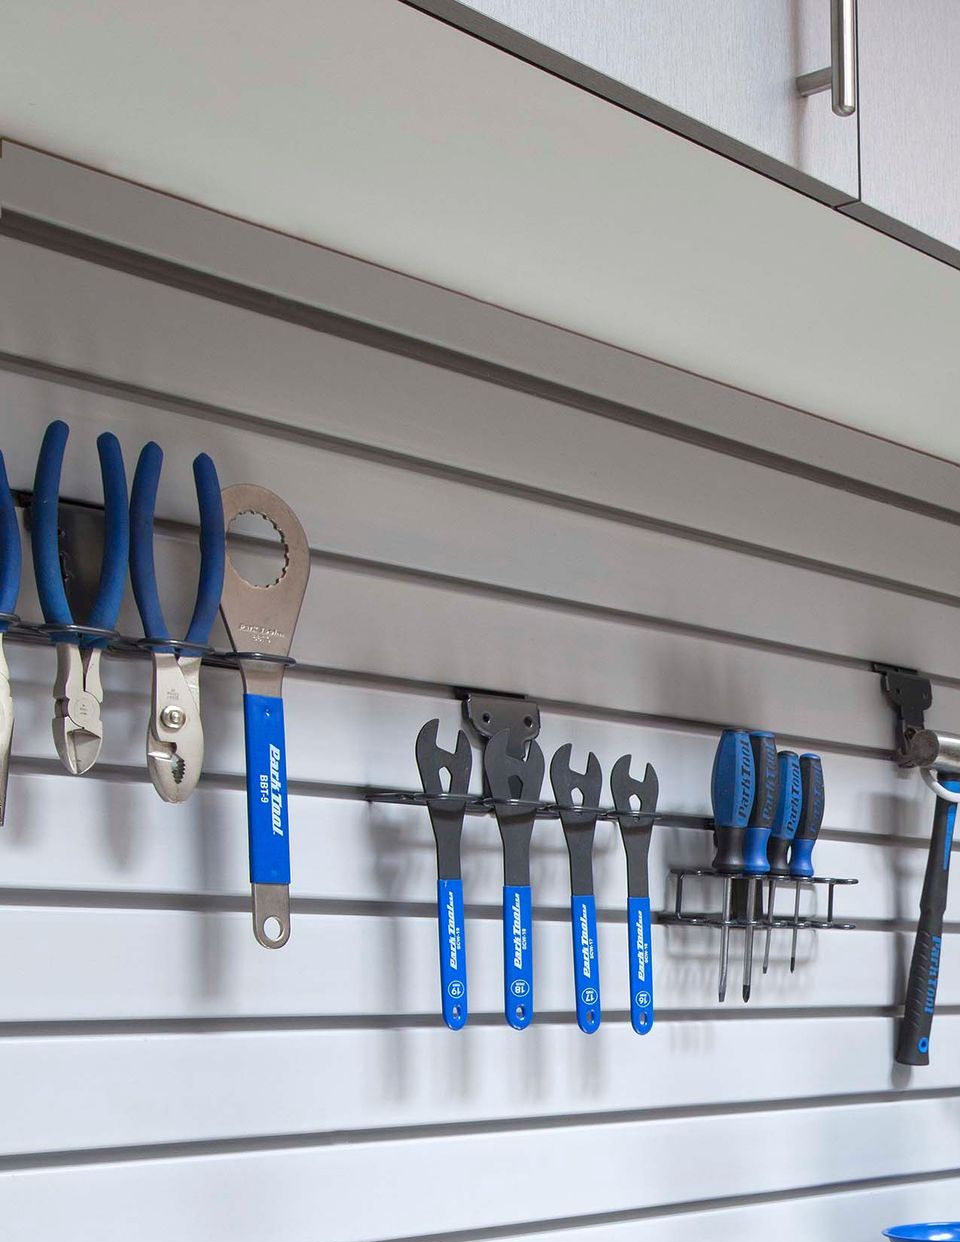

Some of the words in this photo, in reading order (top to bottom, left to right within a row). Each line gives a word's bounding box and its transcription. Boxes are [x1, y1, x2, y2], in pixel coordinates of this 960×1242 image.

[269, 743, 281, 791] Park
[260, 774, 269, 804] BBT-9
[271, 790, 284, 837] Tool
[451, 987, 461, 995] 19
[514, 986, 526, 994] 18
[585, 993, 595, 1002] 17
[638, 996, 648, 1005] 16
